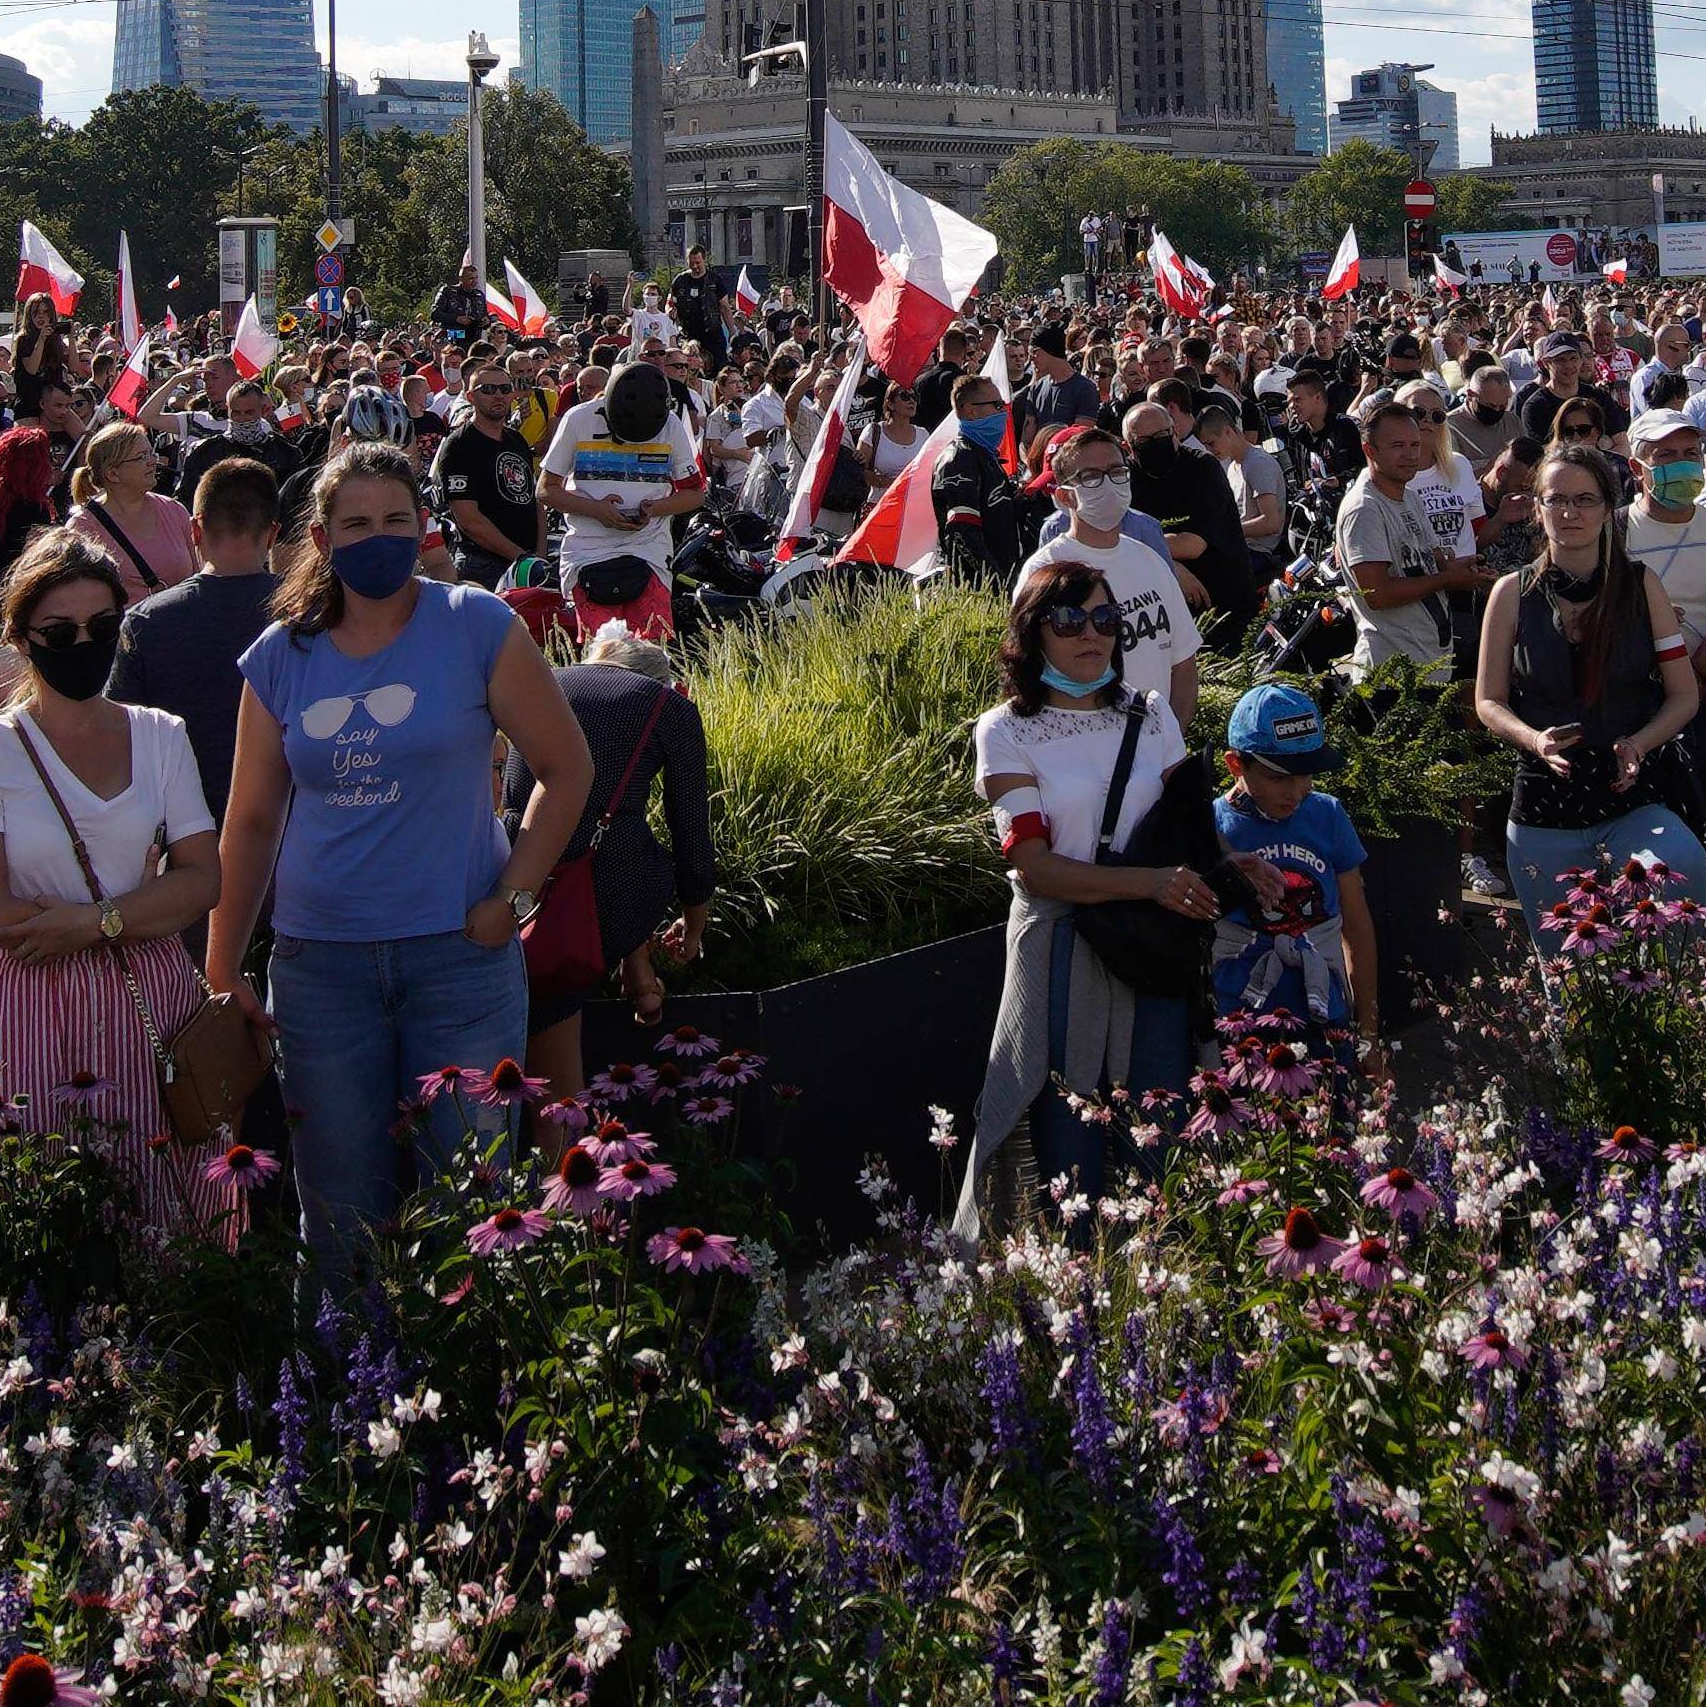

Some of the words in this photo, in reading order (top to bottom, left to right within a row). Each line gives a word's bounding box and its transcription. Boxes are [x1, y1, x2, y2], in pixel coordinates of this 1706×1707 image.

[1117, 589, 1162, 616] SZAWA
[335, 727, 380, 745] say
[333, 746, 381, 778] Yes
[325, 781, 402, 806] weekend
[1282, 843, 1326, 873] HERO
